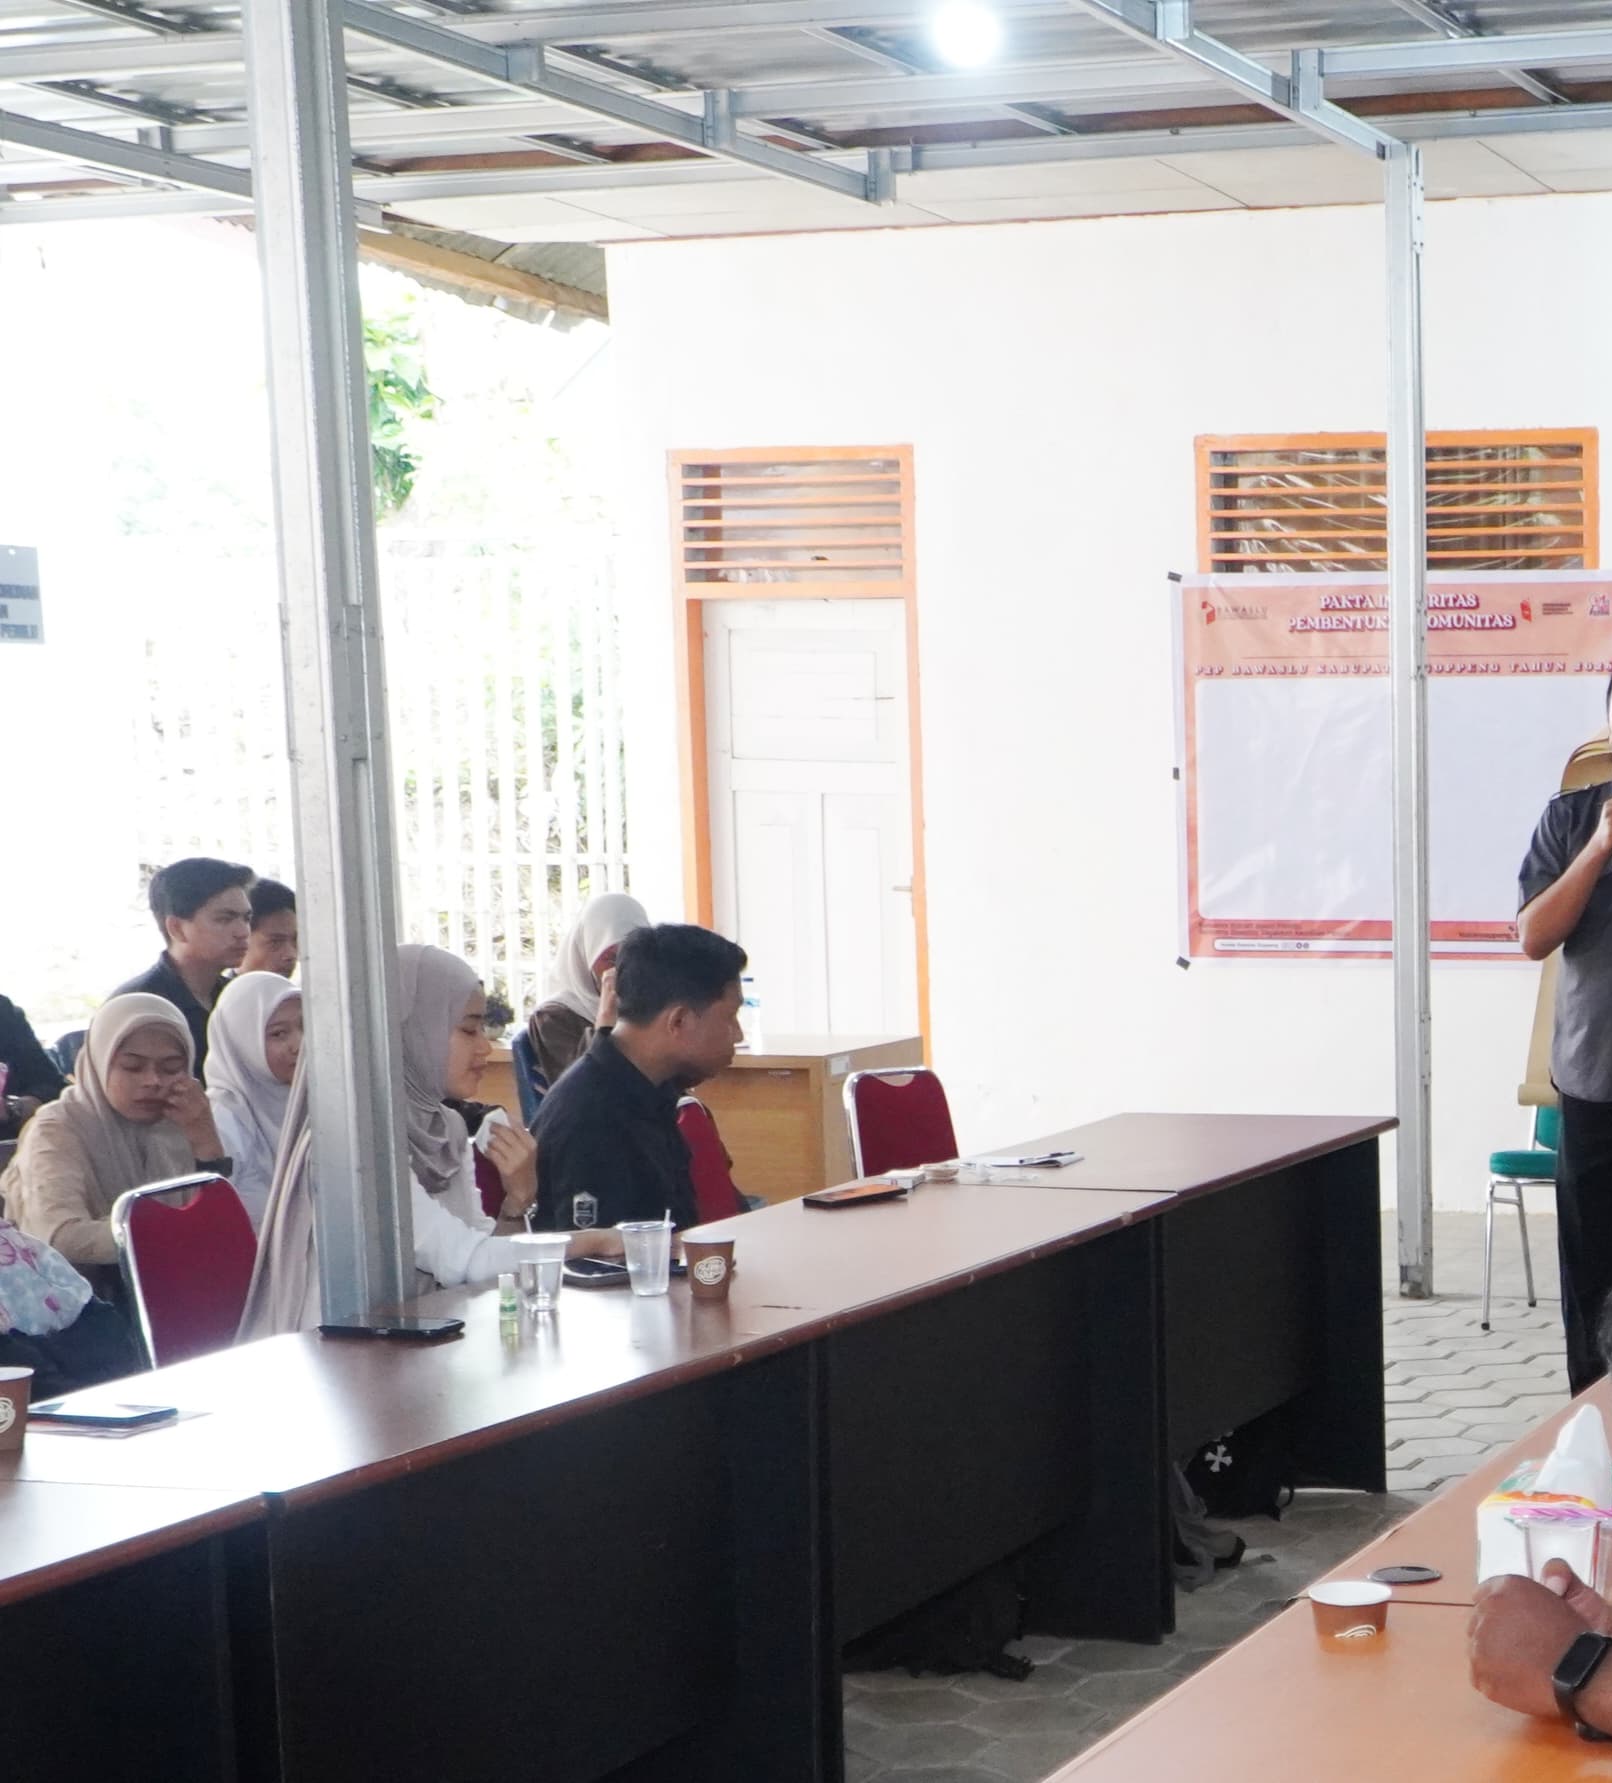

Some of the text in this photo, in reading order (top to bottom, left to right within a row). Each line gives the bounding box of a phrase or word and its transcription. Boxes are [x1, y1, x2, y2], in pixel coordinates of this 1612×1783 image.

[1319, 594, 1375, 611] PAKTA
[1426, 613, 1517, 631] OMUNITAS
[1511, 661, 1567, 673] TAHUN
